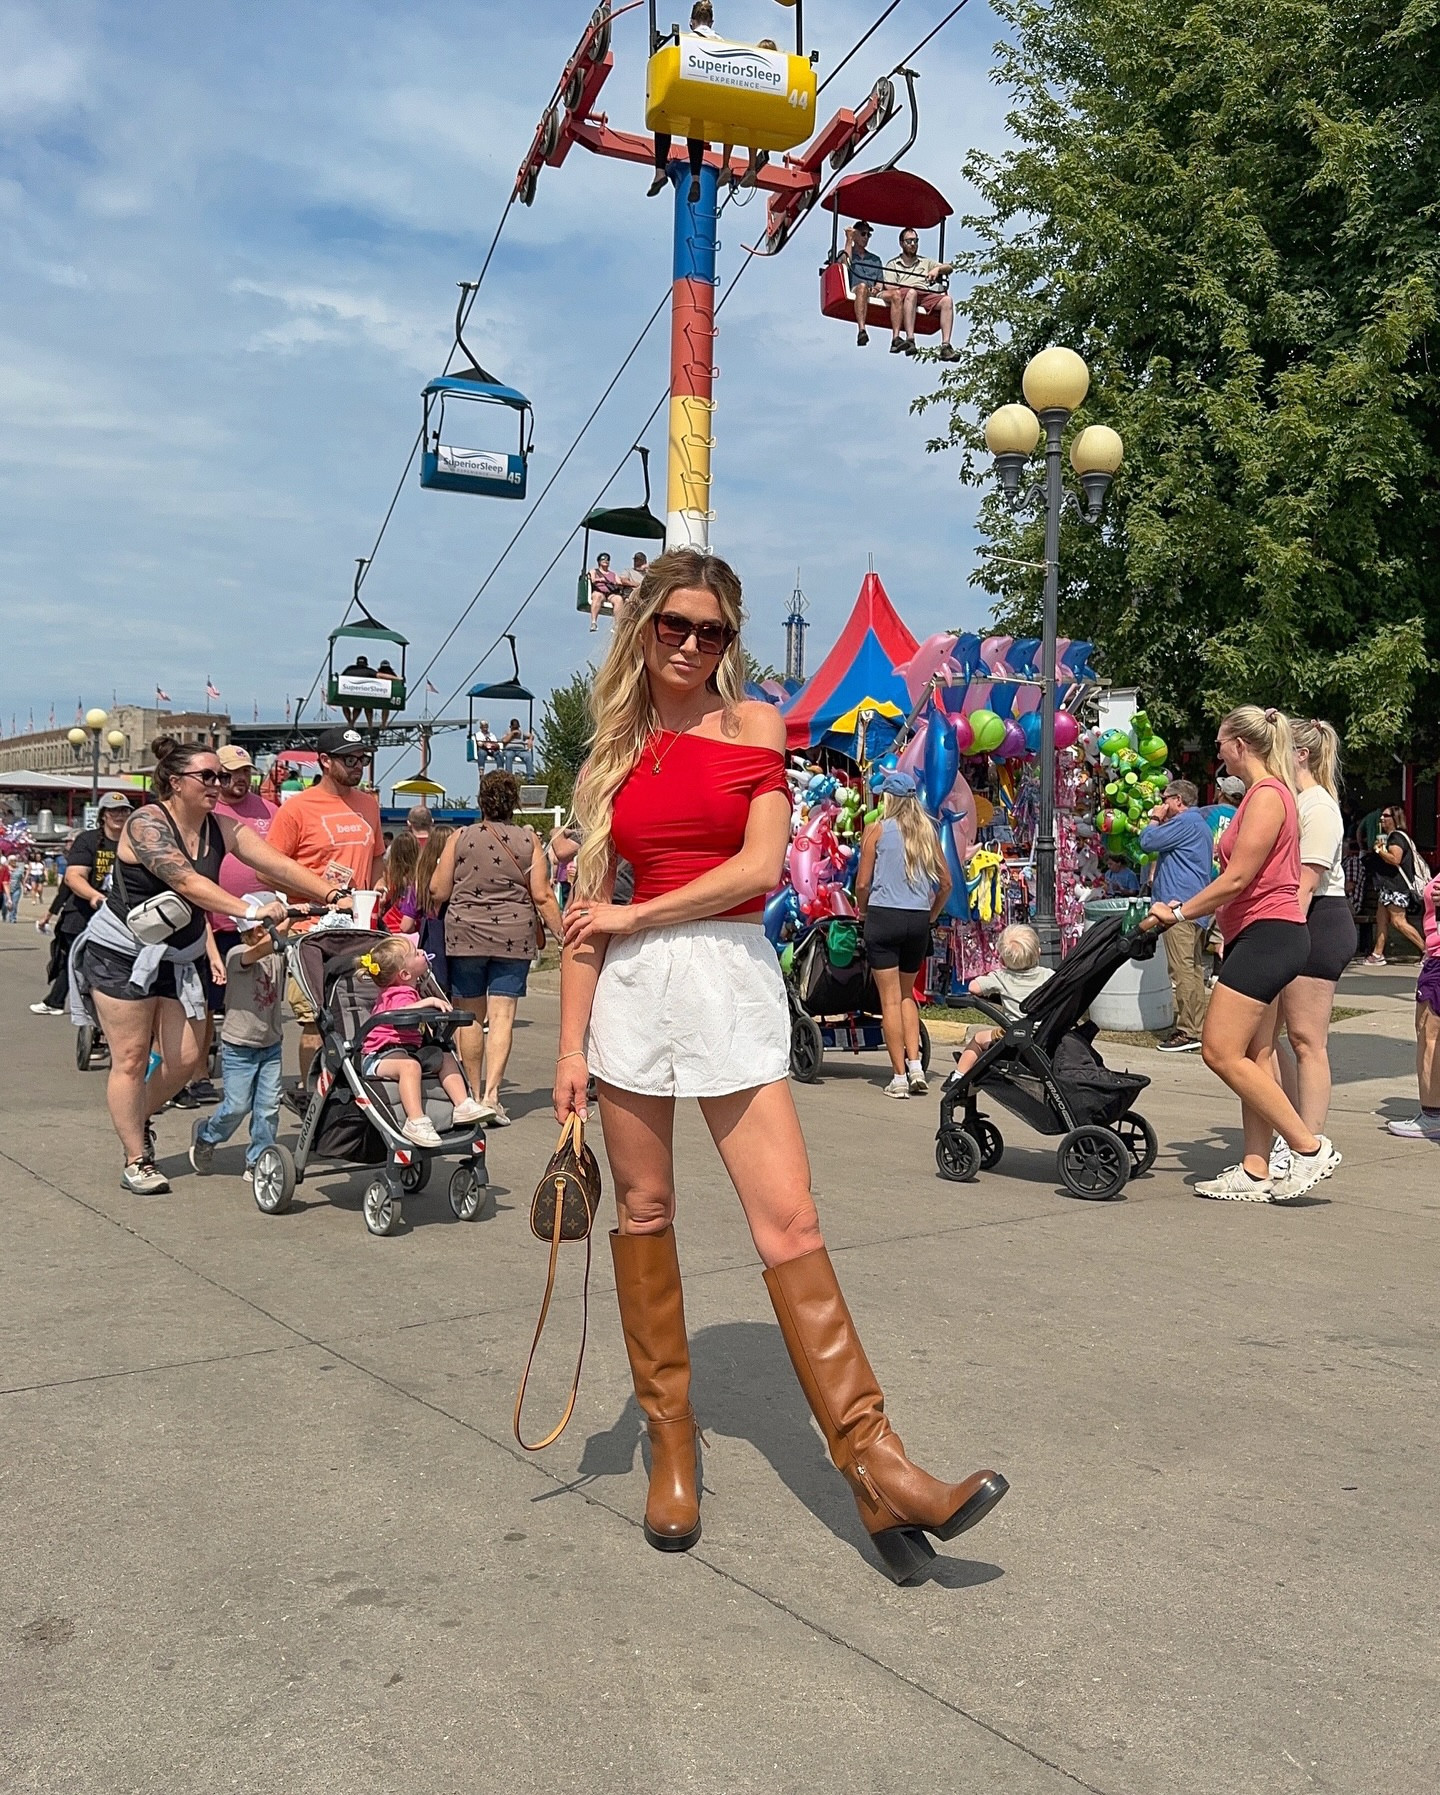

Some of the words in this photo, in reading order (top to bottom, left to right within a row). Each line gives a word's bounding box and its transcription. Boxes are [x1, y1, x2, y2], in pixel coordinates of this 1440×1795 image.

[688, 55, 781, 85] SuperiorSleep
[709, 74, 760, 89] EXPERIENCE
[788, 88, 809, 110] 44
[443, 457, 503, 474] SuperiorSleep
[508, 471, 521, 484] 45
[342, 683, 388, 694] SuperiorSleep
[336, 823, 362, 833] beer
[97, 850, 115, 859] THIS
[1045, 1080, 1066, 1110] BRAVO
